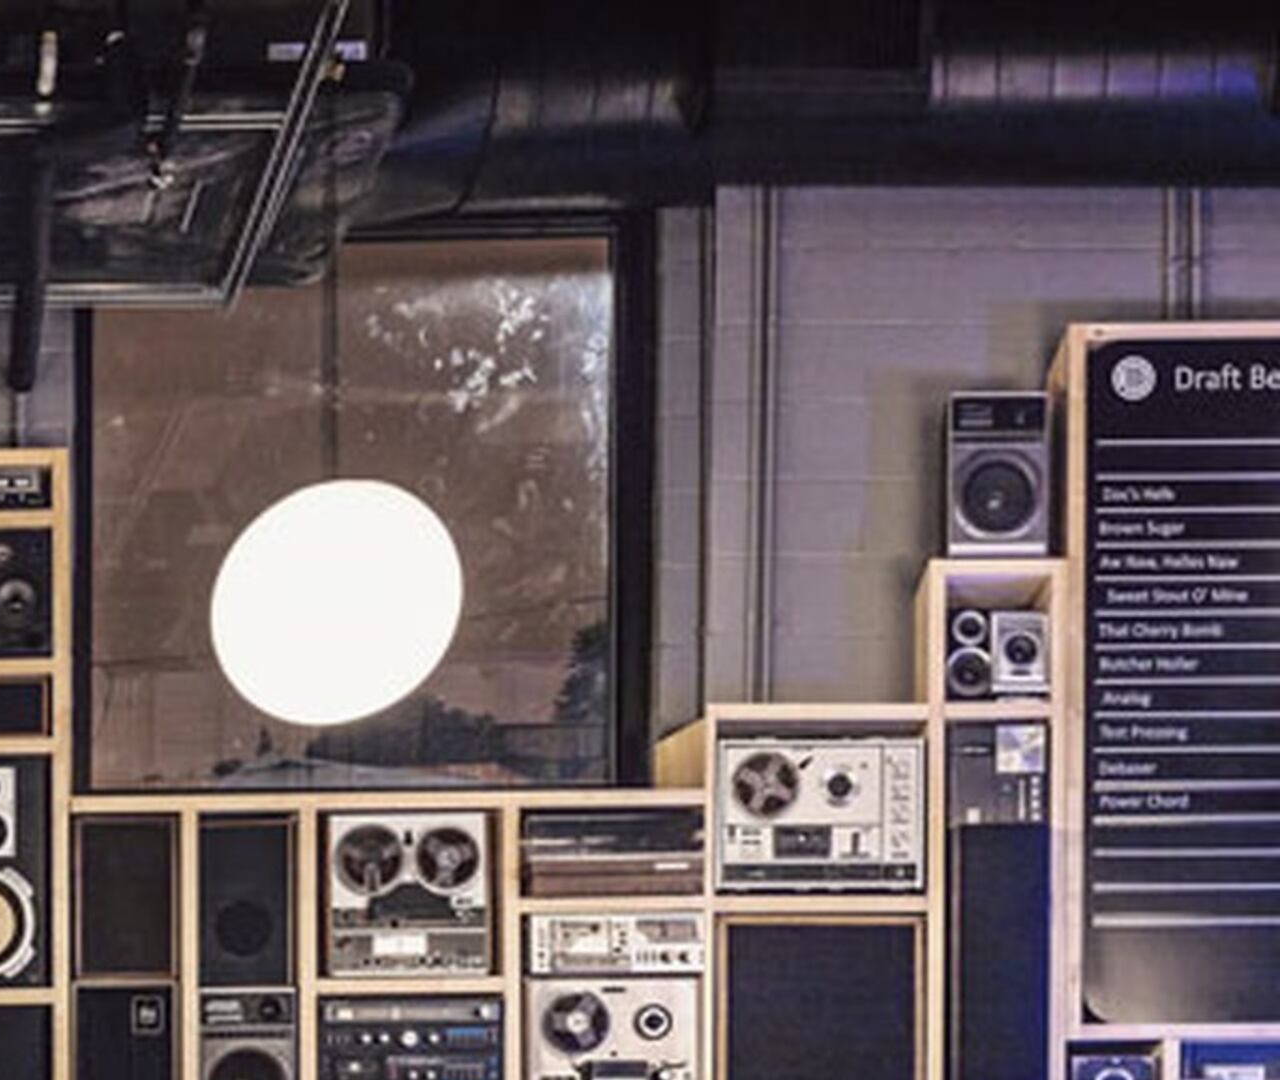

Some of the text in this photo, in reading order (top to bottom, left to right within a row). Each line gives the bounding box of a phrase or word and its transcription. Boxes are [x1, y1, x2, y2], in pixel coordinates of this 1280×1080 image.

[1174, 363, 1242, 391] Draft
[1098, 520, 1185, 537] Brown Sugar
[1107, 589, 1148, 603] Sweet
[1152, 588, 1188, 603] Stout
[1211, 588, 1248, 603] Mine
[1132, 623, 1177, 639] Cherry
[1182, 622, 1223, 637] Bomb
[1099, 656, 1152, 671] Butcher
[1101, 690, 1152, 708] Analog
[1099, 792, 1190, 809] Power Chord
